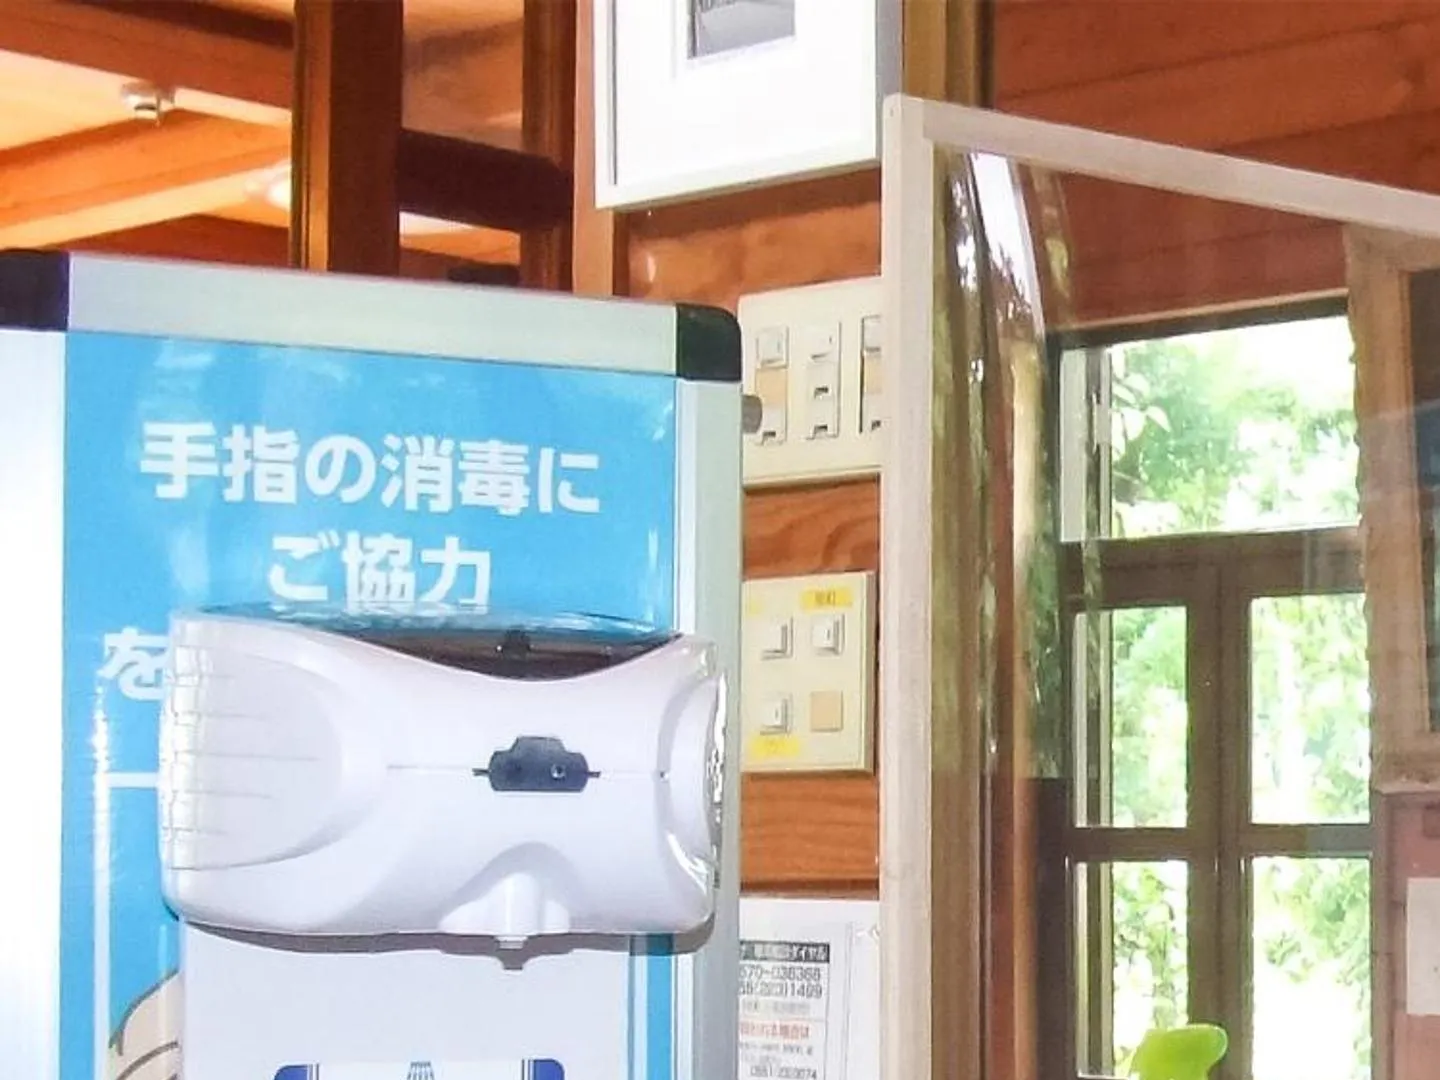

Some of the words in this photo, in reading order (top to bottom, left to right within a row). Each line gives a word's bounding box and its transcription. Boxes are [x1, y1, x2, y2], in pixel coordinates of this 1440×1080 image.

[140, 421, 601, 516] 手指の消毒に
[267, 530, 492, 615] ご協力
